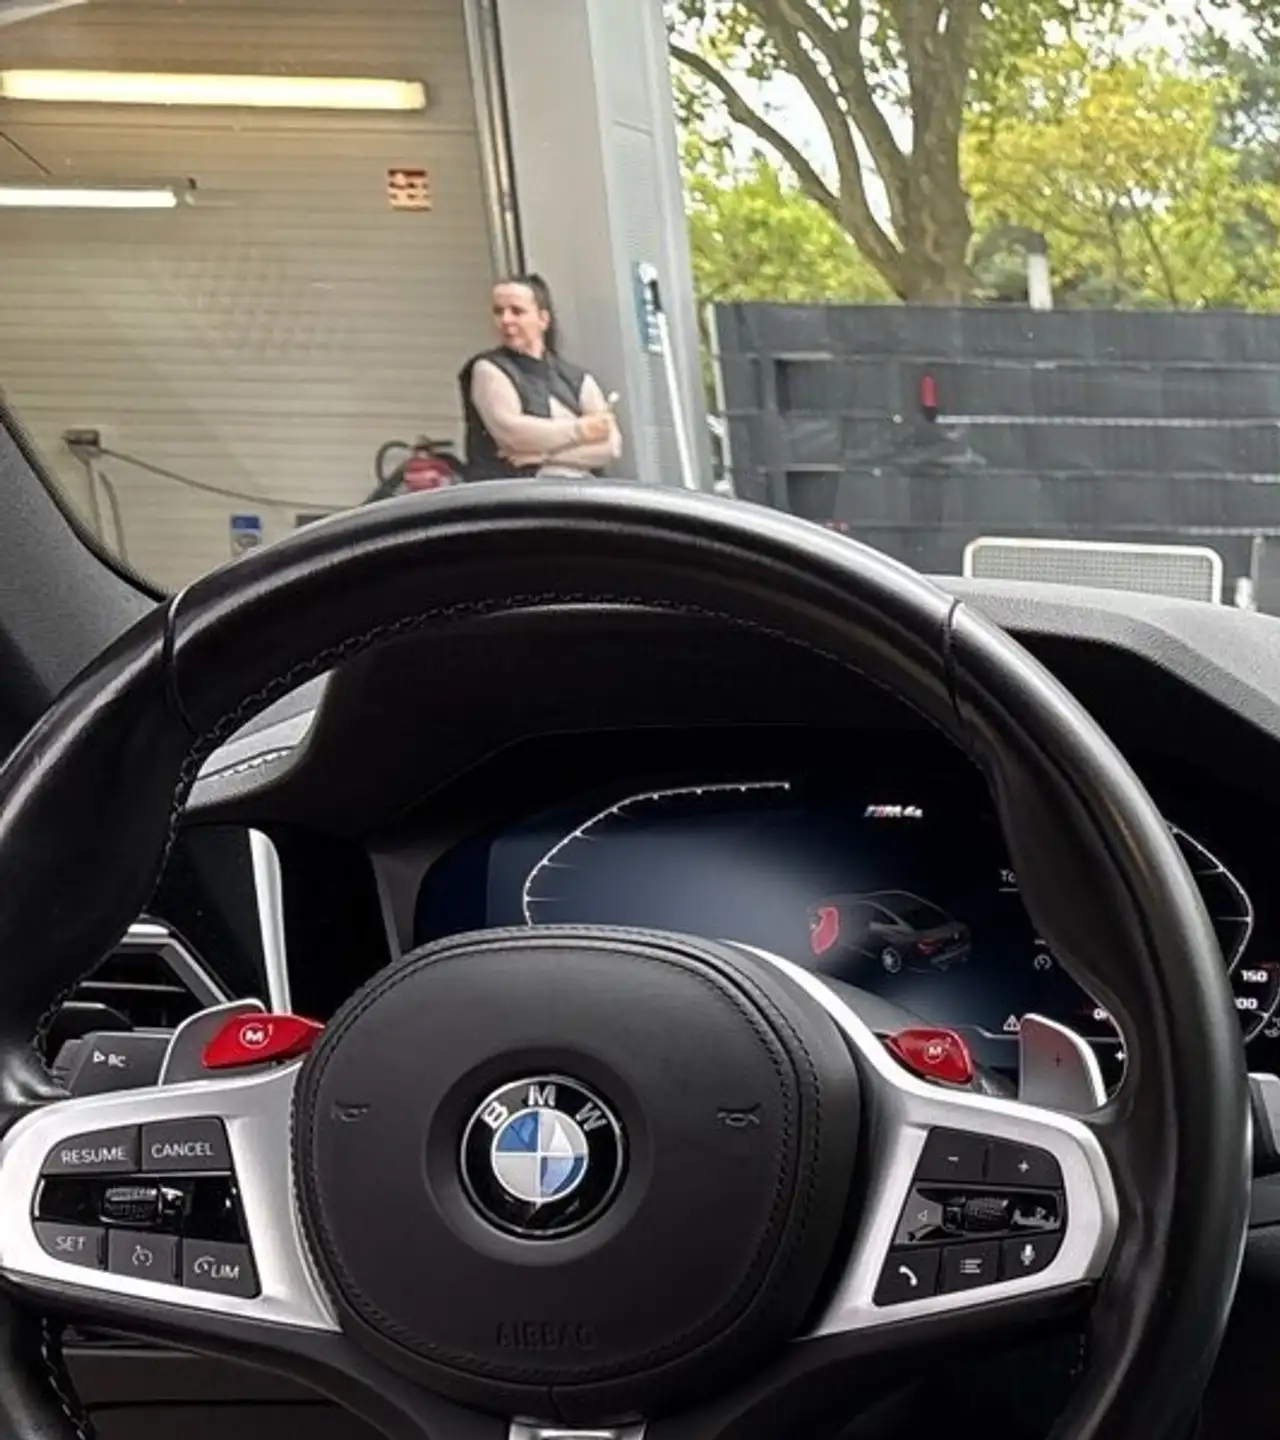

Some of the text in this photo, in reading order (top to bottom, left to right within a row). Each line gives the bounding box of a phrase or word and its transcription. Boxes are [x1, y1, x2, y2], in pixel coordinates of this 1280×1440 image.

[480, 1084, 608, 1132] BMW
[61, 1146, 128, 1164] RESUME
[151, 1142, 214, 1158] CANCEL
[55, 1235, 86, 1251] SET
[211, 1264, 240, 1279] LIM
